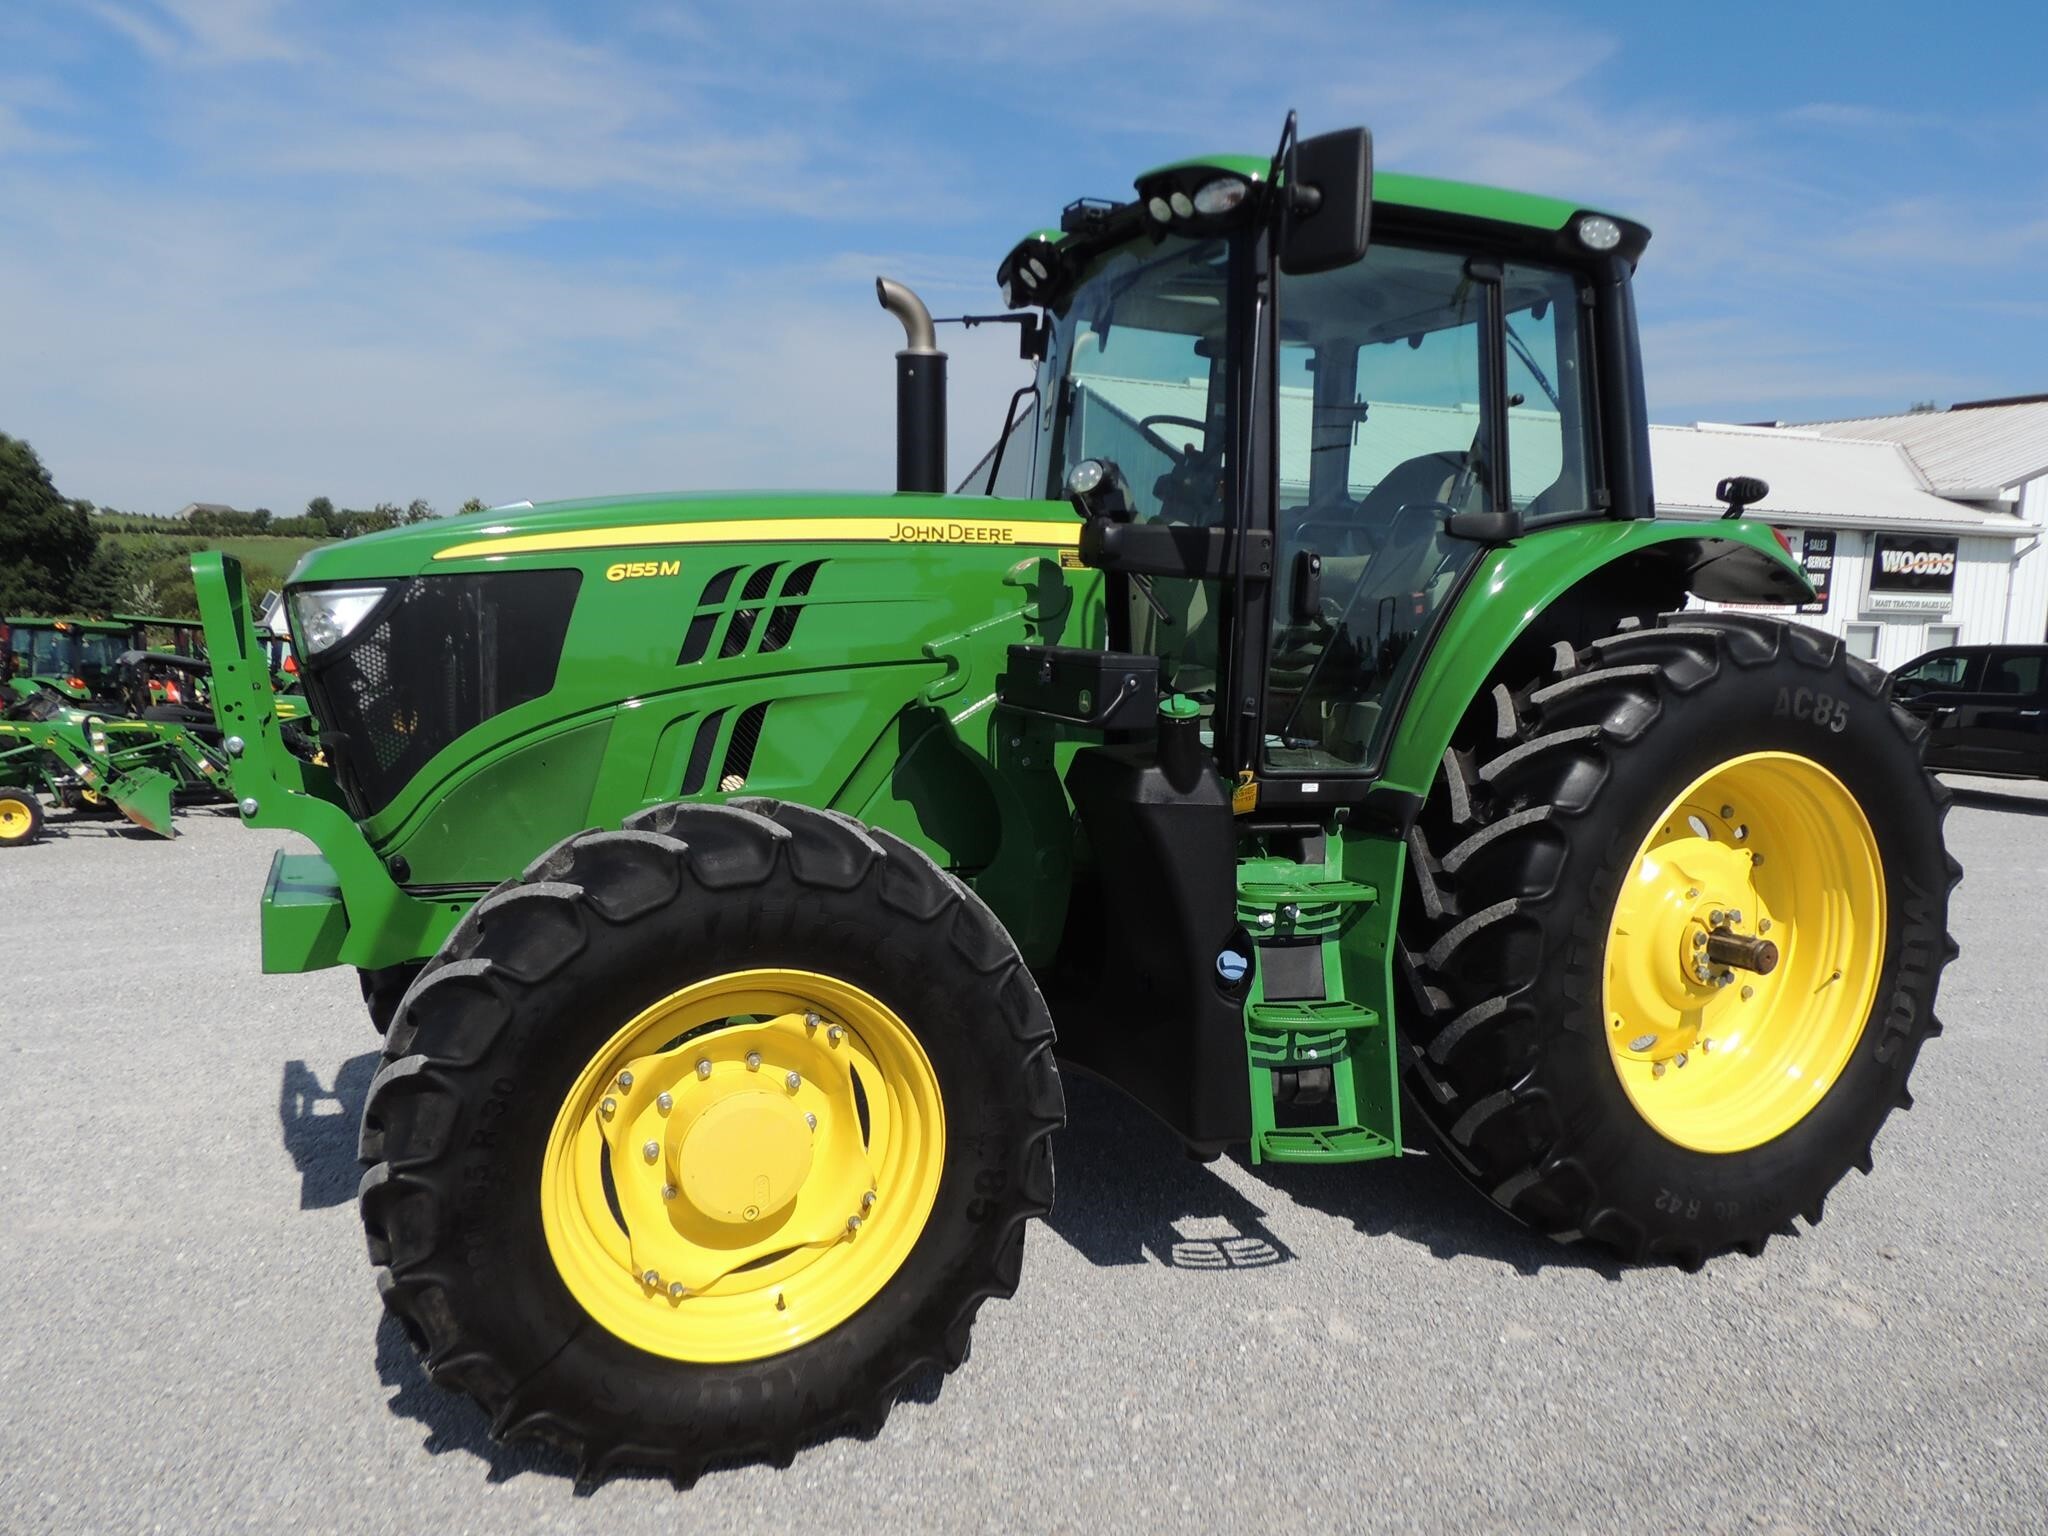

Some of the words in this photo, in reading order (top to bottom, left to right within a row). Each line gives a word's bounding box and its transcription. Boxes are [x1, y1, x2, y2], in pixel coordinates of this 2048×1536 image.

[889, 522, 944, 540] JOHN
[948, 524, 1014, 542] DEERE
[1808, 538, 1828, 552] SALES
[1806, 555, 1832, 570] SERVICE
[1881, 550, 1955, 576] WOODS
[1874, 599, 1892, 608] MAST
[1893, 600, 1921, 609] TRACTOR
[1921, 601, 1939, 609] SALES
[1940, 602, 1951, 610] LLC
[1772, 686, 1850, 734] AC85
